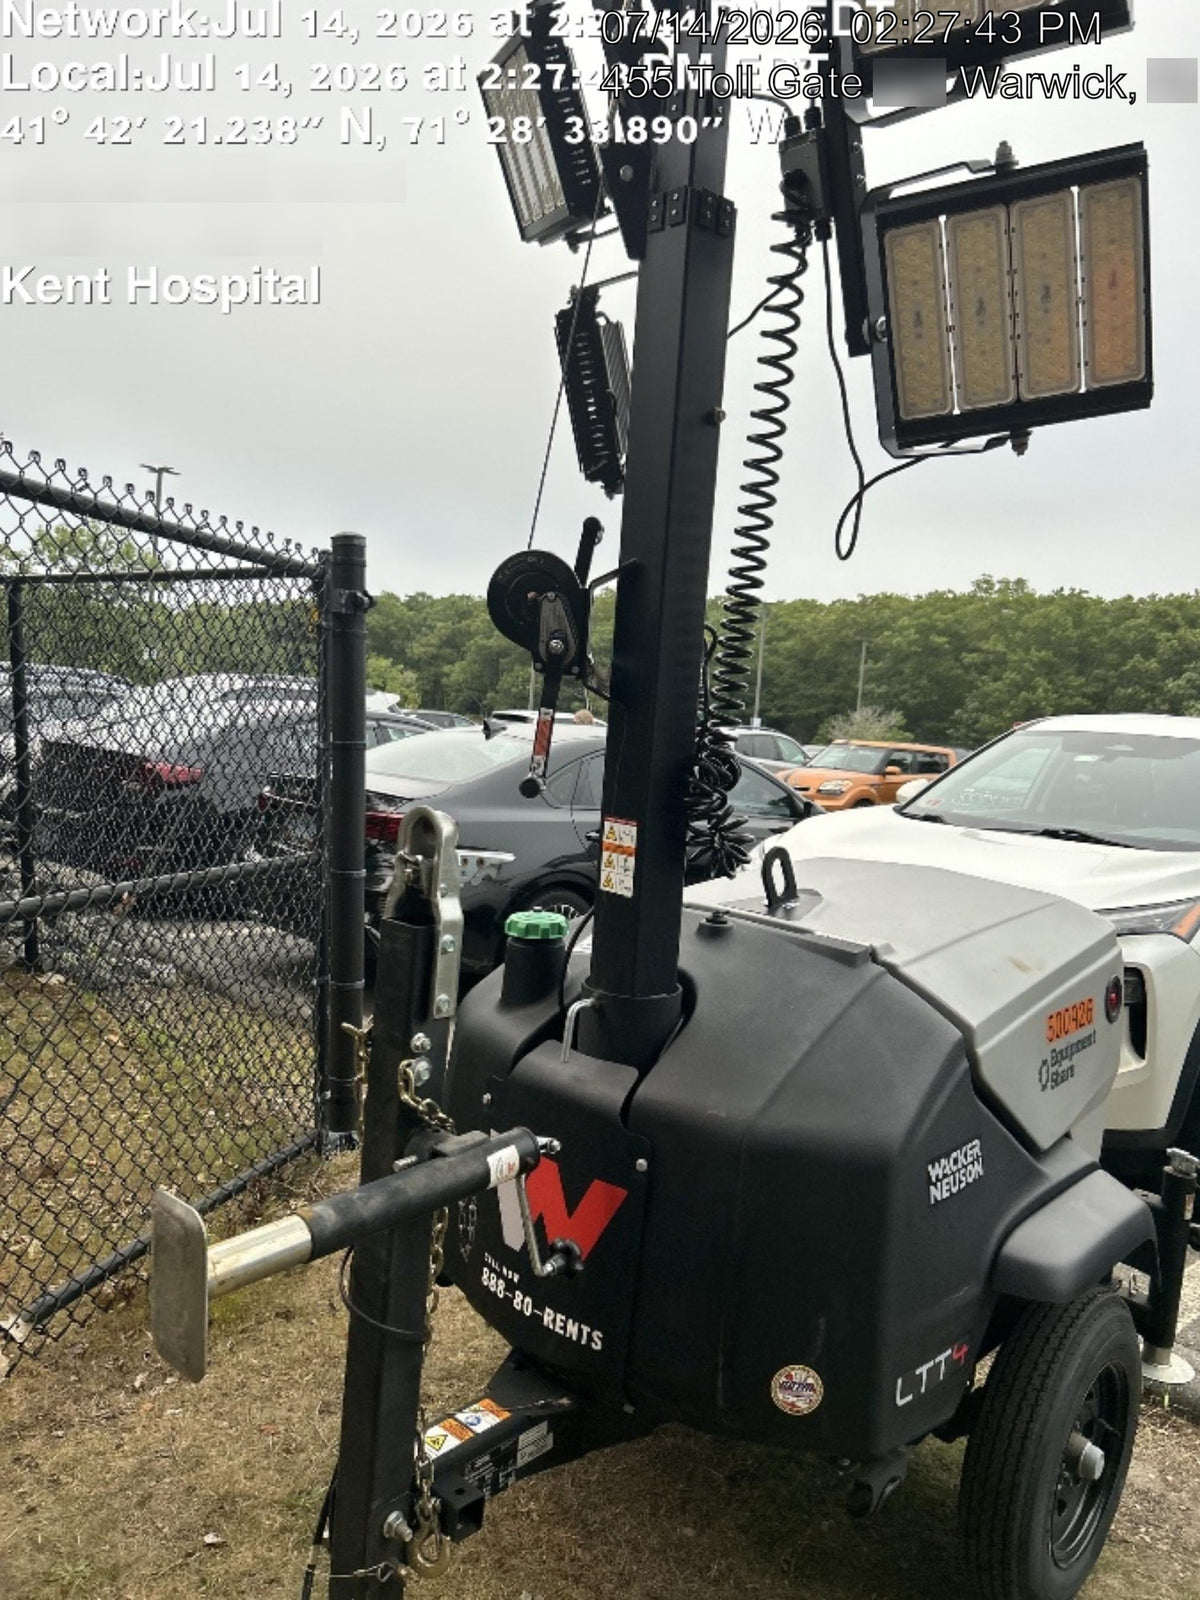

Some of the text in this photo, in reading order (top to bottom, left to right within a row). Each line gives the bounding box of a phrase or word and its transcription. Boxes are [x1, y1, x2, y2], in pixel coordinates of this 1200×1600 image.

[927, 1138, 983, 1183] WACKER
[929, 1156, 984, 1205] NEUSON
[481, 1266, 604, 1351] 888-80-RENTS
